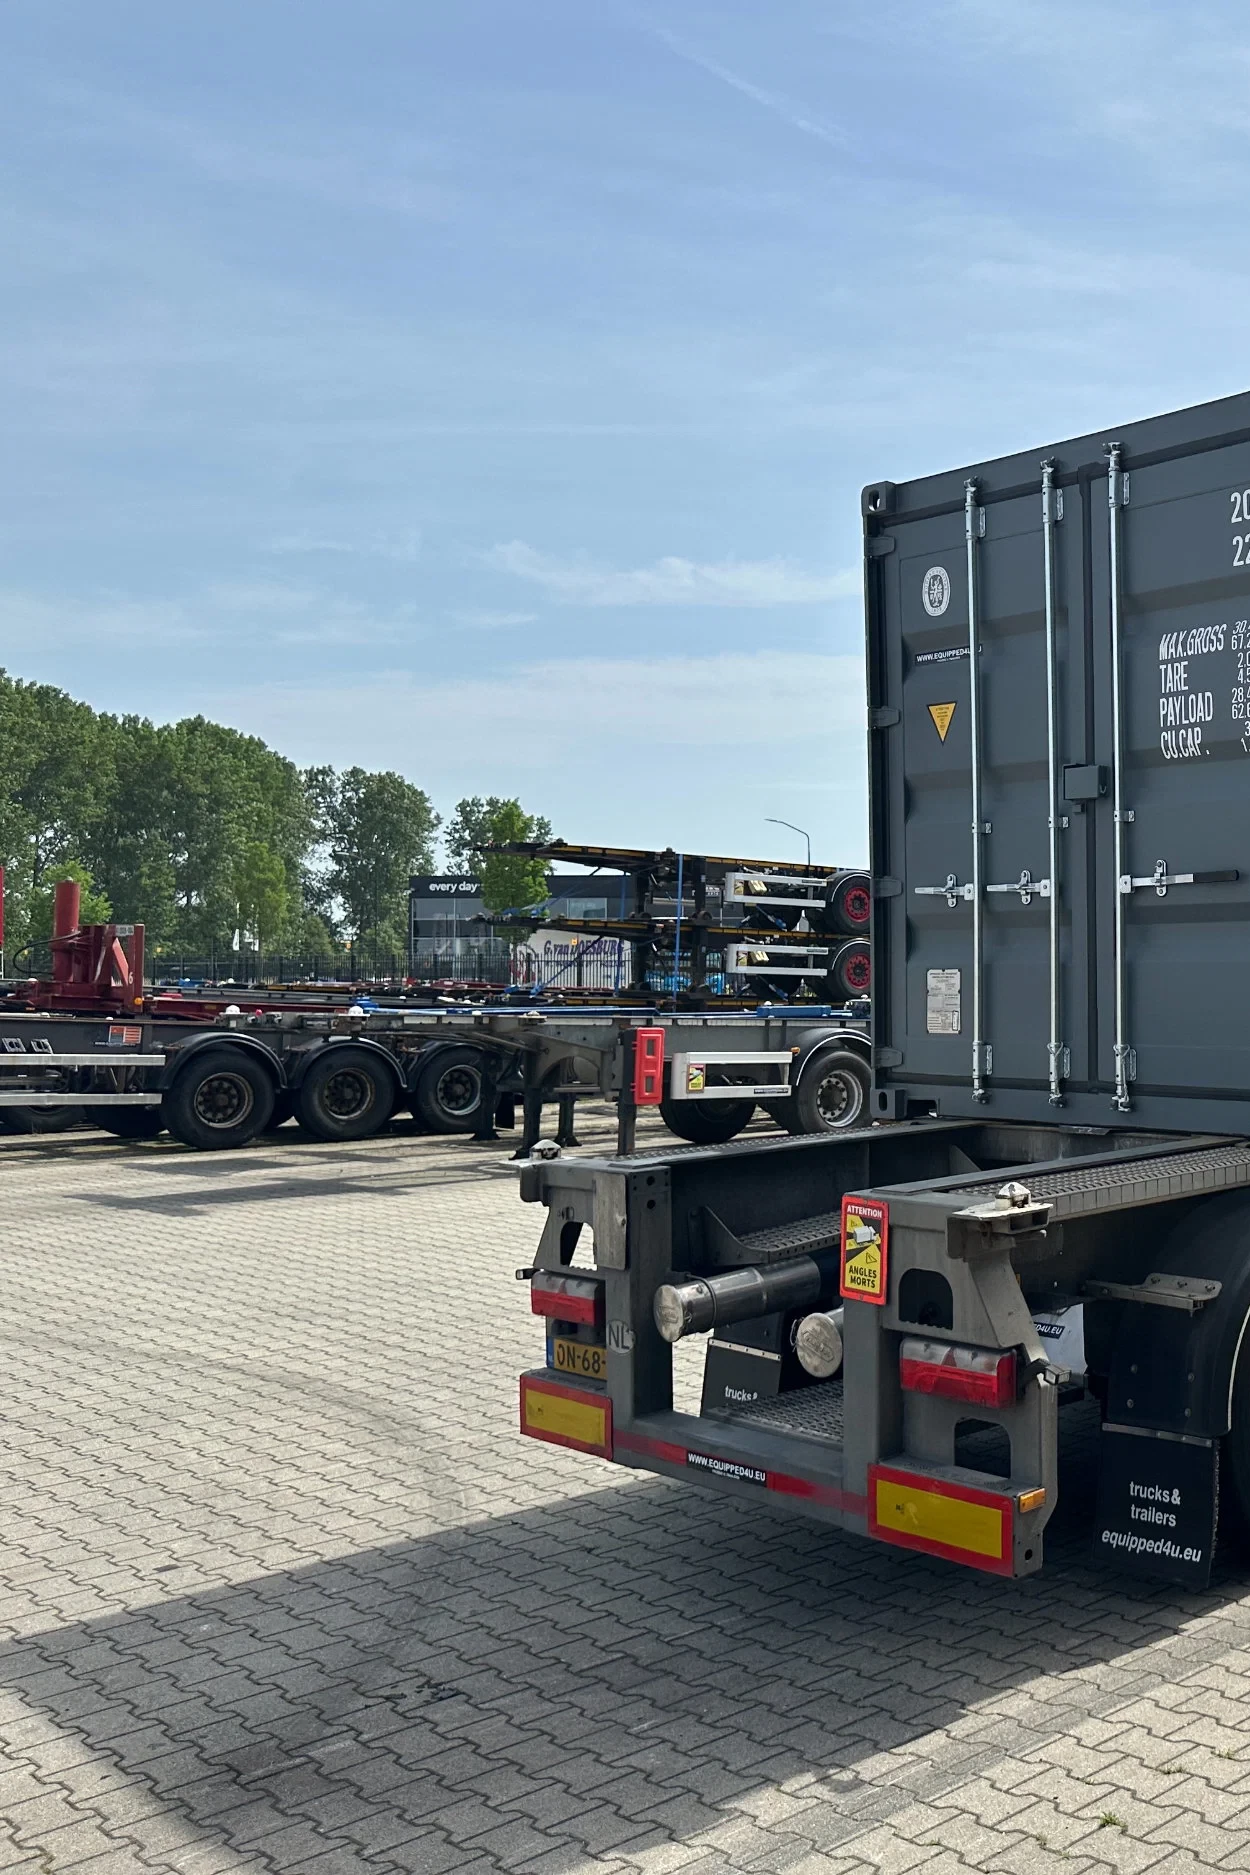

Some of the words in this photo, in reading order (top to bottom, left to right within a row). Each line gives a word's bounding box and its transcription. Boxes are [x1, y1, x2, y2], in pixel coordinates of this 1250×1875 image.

[1159, 623, 1227, 661] MAX.GROSS
[1159, 661, 1189, 694] TARE
[1159, 691, 1213, 727] PAYLOAD
[429, 883, 457, 893] every
[458, 881, 478, 893] day
[847, 1204, 883, 1218] ATTENTION
[849, 1265, 877, 1279] ANGLES
[850, 1275, 876, 1289] MORTS
[608, 1323, 630, 1350] NL
[687, 1452, 766, 1482] WWW.EQUIPPED4U.EU
[1129, 1480, 1181, 1506] trucks&
[1130, 1504, 1177, 1527] trailers
[1101, 1529, 1202, 1563] equipped4u.eu
